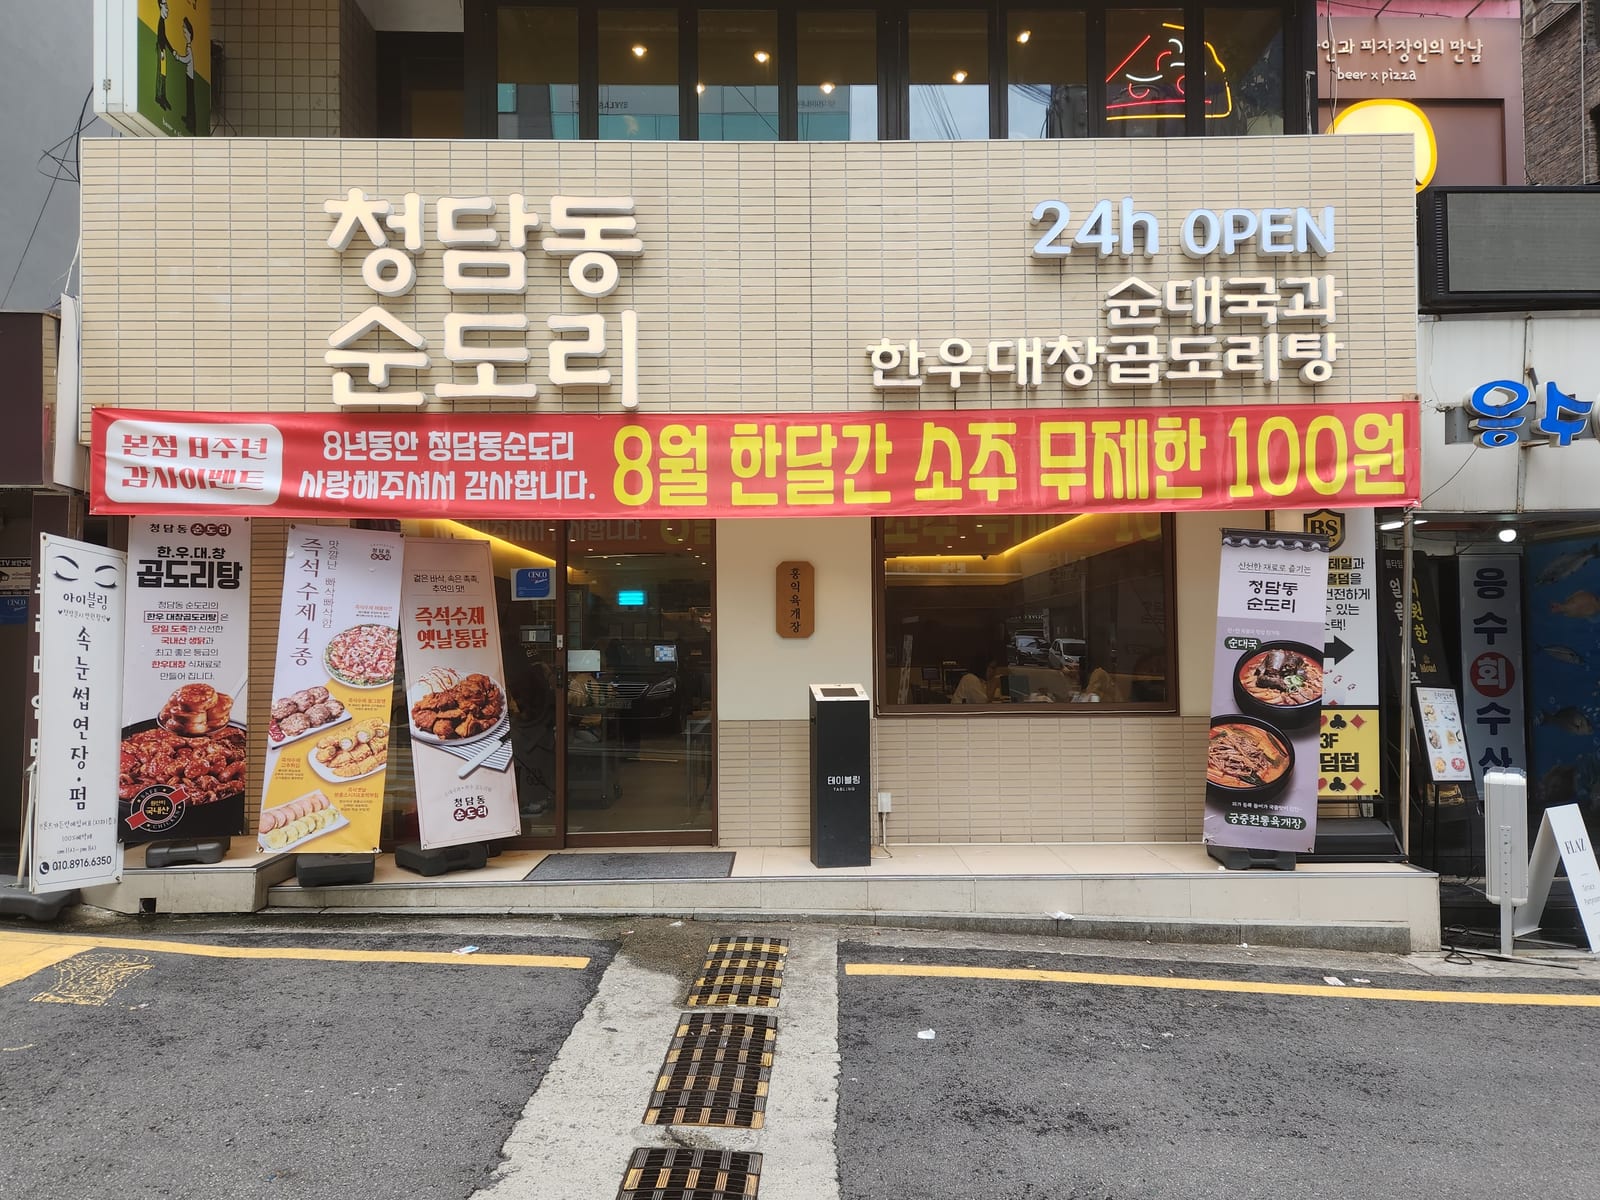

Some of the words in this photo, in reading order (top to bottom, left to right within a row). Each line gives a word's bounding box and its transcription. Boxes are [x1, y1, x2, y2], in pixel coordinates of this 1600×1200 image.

[1317, 39, 1355, 63] 인과
[1450, 38, 1483, 64] 만남
[1337, 67, 1367, 80] beer
[1371, 72, 1378, 80] x
[1382, 68, 1416, 85] pizza
[1031, 197, 1159, 259] 24h
[1182, 206, 1336, 258] OPEN
[324, 187, 643, 298] 청담동
[1106, 275, 1343, 328] 순대국과
[324, 306, 638, 409] 순도리
[122, 435, 177, 458] 본점
[189, 437, 268, 460] 8주년
[323, 430, 419, 461] 8년동안
[428, 431, 574, 461] 청담동순도리
[613, 424, 707, 506] 8월
[730, 422, 892, 506] 한달간
[914, 421, 1017, 502] 소주
[1039, 417, 1206, 501] 무제한
[1229, 413, 1405, 498] 100원
[121, 466, 265, 490] 감사이벤트
[298, 470, 455, 500] 사랑해주셔서
[465, 470, 596, 500] 감사합니다.
[150, 524, 187, 533] 청담동
[191, 523, 231, 536] 순도리
[1310, 518, 1338, 538] BS
[300, 538, 323, 578] 즉석
[137, 560, 243, 589] 곱도리탕
[1238, 562, 1262, 571] 신선한
[1263, 563, 1287, 572] 재료로
[1288, 564, 1311, 574] 즐기는
[448, 575, 462, 583] 속은
[1248, 580, 1298, 596] 청담동
[433, 585, 454, 593] 추억의
[63, 592, 107, 610] 아이블링
[296, 582, 319, 621] 수제
[790, 567, 801, 633] 홍익육개장
[1247, 597, 1296, 613] 순도리
[1336, 603, 1360, 616] 있는
[147, 613, 165, 621] 한우
[416, 606, 485, 626] 즉석수제
[151, 625, 169, 633] 당일
[198, 625, 223, 633] 신선한
[290, 628, 313, 666] 4종
[417, 628, 489, 650] 옛날통닭
[1228, 638, 1258, 649] 순대국
[151, 660, 186, 669] 한우대창
[188, 660, 221, 668] 식재료로
[454, 794, 485, 807] 청담동
[145, 807, 169, 815] 국내산
[454, 806, 488, 821] 순도리
[1228, 813, 1303, 829] 궁중전통육개장
[52, 855, 112, 871] 010.8916.6350
